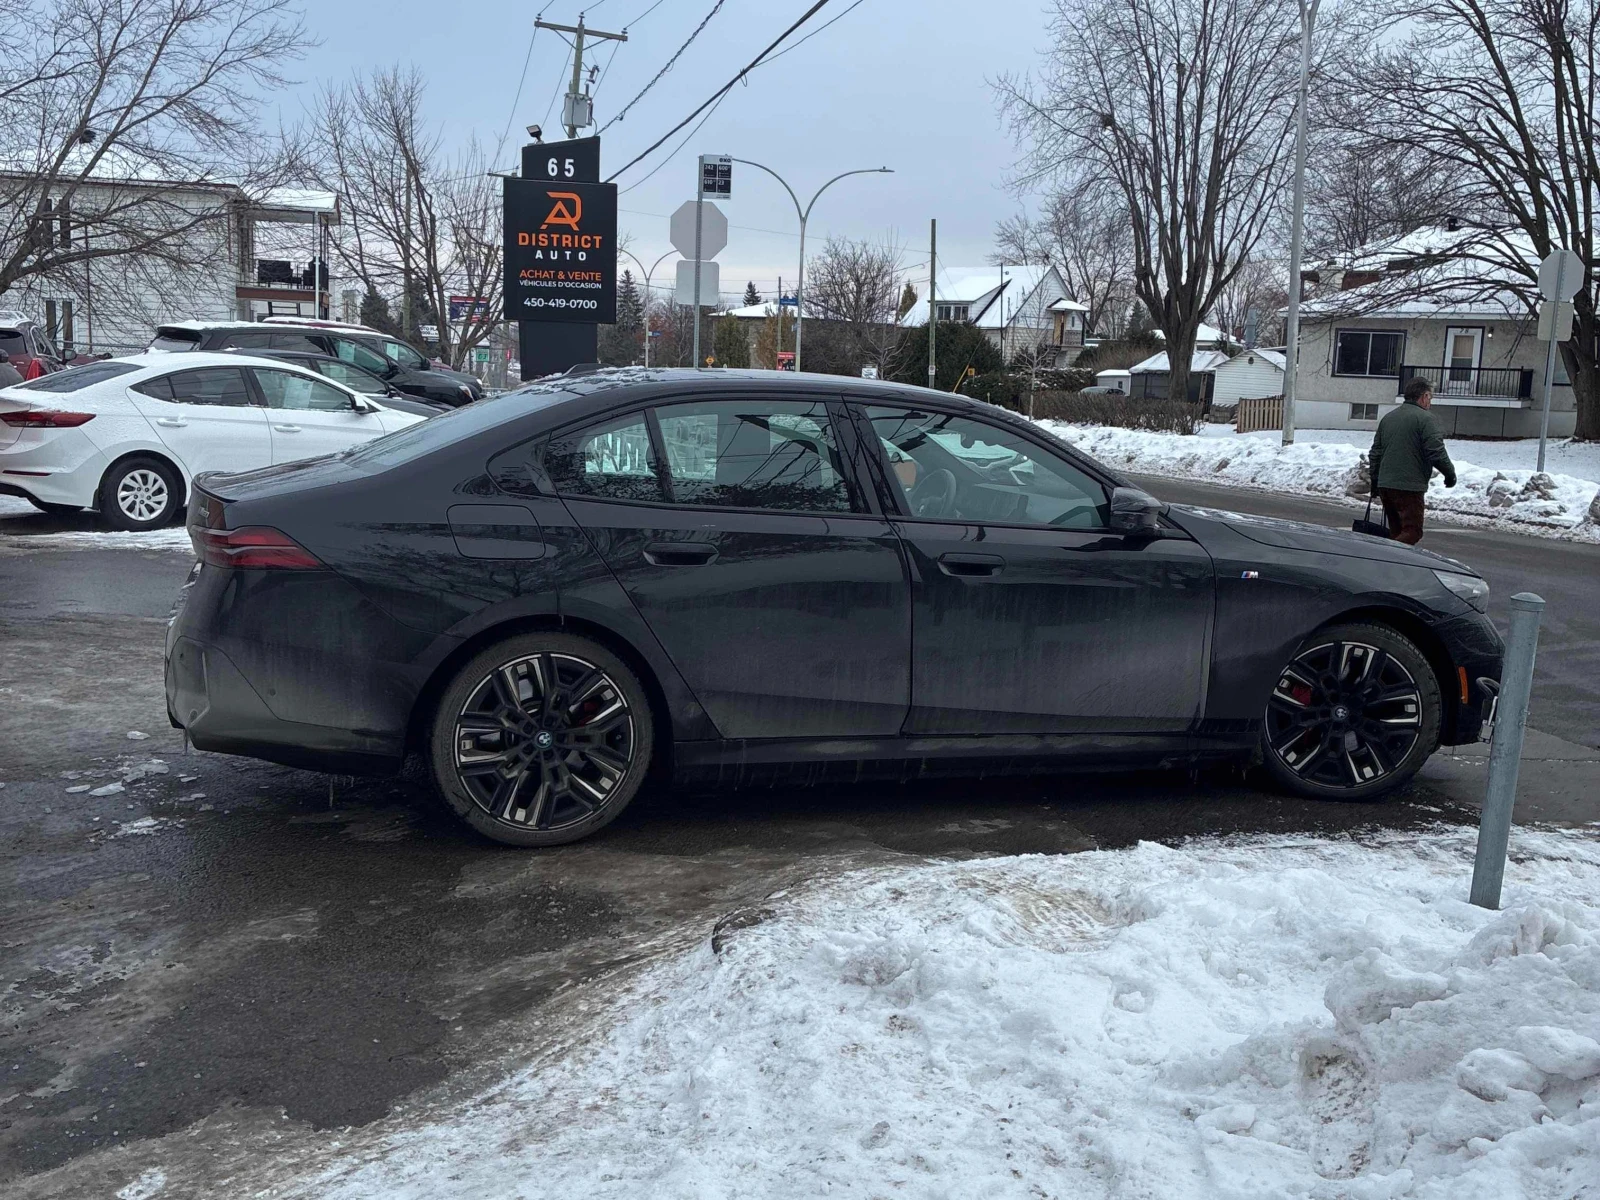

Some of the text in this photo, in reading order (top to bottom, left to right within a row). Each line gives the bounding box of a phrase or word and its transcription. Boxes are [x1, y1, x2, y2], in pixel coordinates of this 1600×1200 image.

[547, 158, 575, 177] 65
[518, 232, 602, 248] DISTRICT
[535, 250, 586, 261] AUTO
[519, 270, 602, 281] ACHAT & VENTE
[519, 280, 602, 289] VÉHICULES D'OCCASION
[523, 297, 598, 309] 450-419-0700
